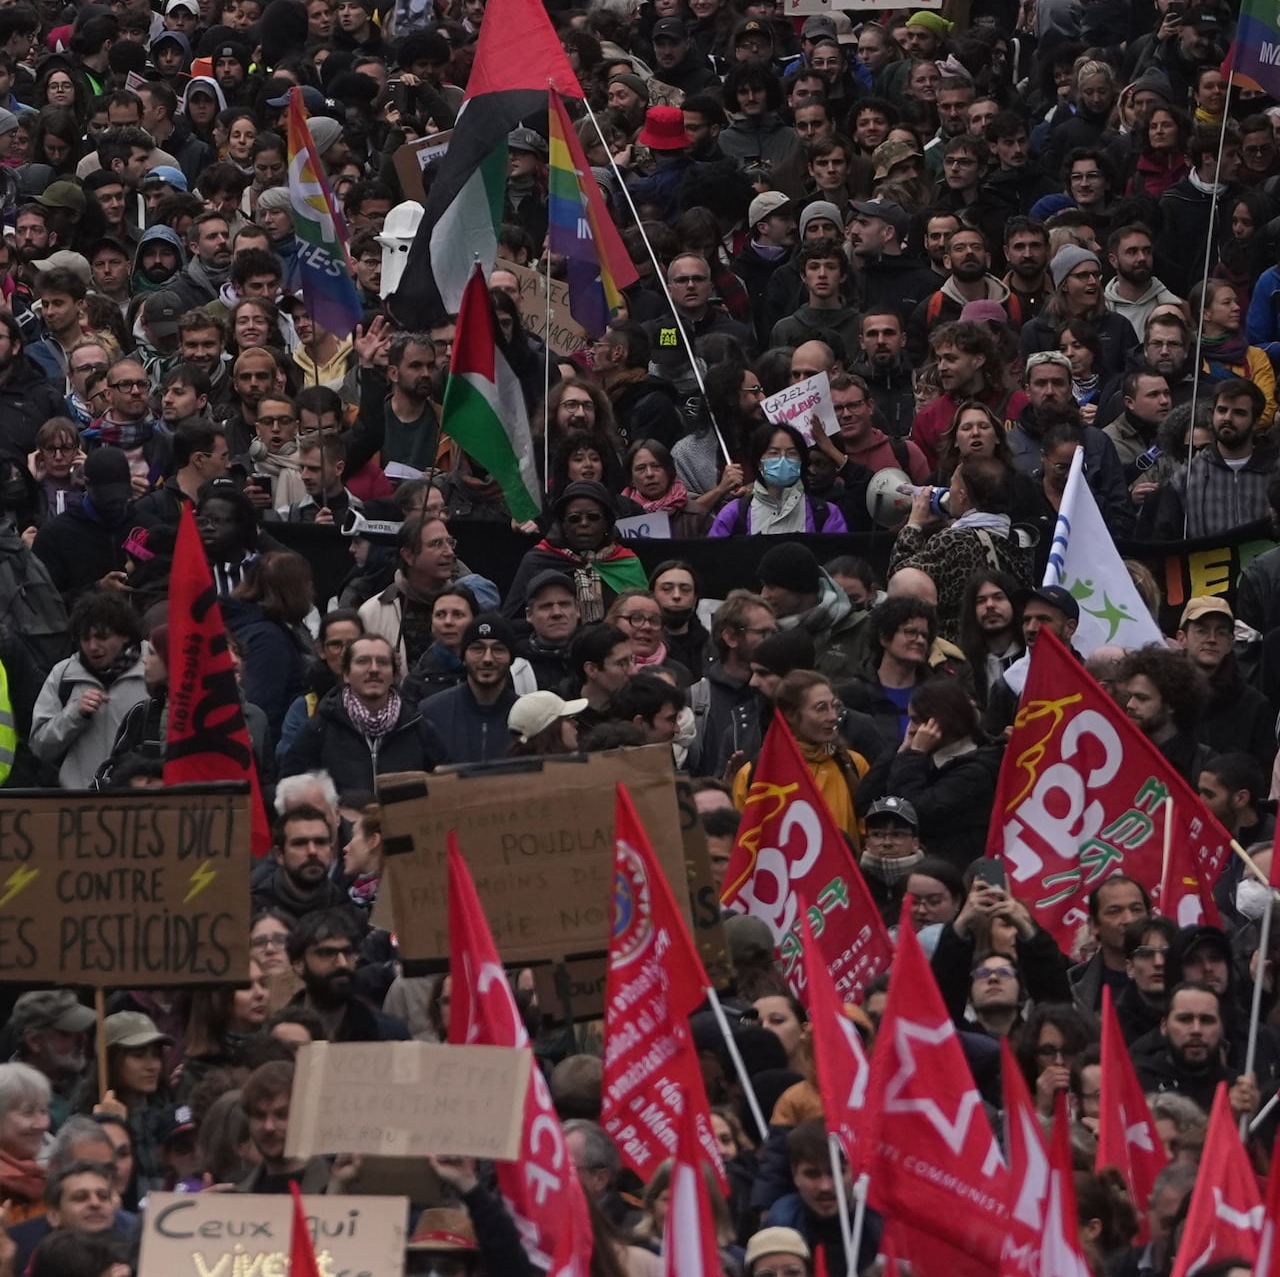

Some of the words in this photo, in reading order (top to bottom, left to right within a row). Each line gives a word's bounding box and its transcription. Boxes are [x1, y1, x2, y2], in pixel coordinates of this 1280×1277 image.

[56, 803, 166, 858] PESTES
[56, 869, 166, 903] CONTRE
[59, 912, 233, 978] PESTICIDES
[154, 1201, 274, 1239] Ceux
